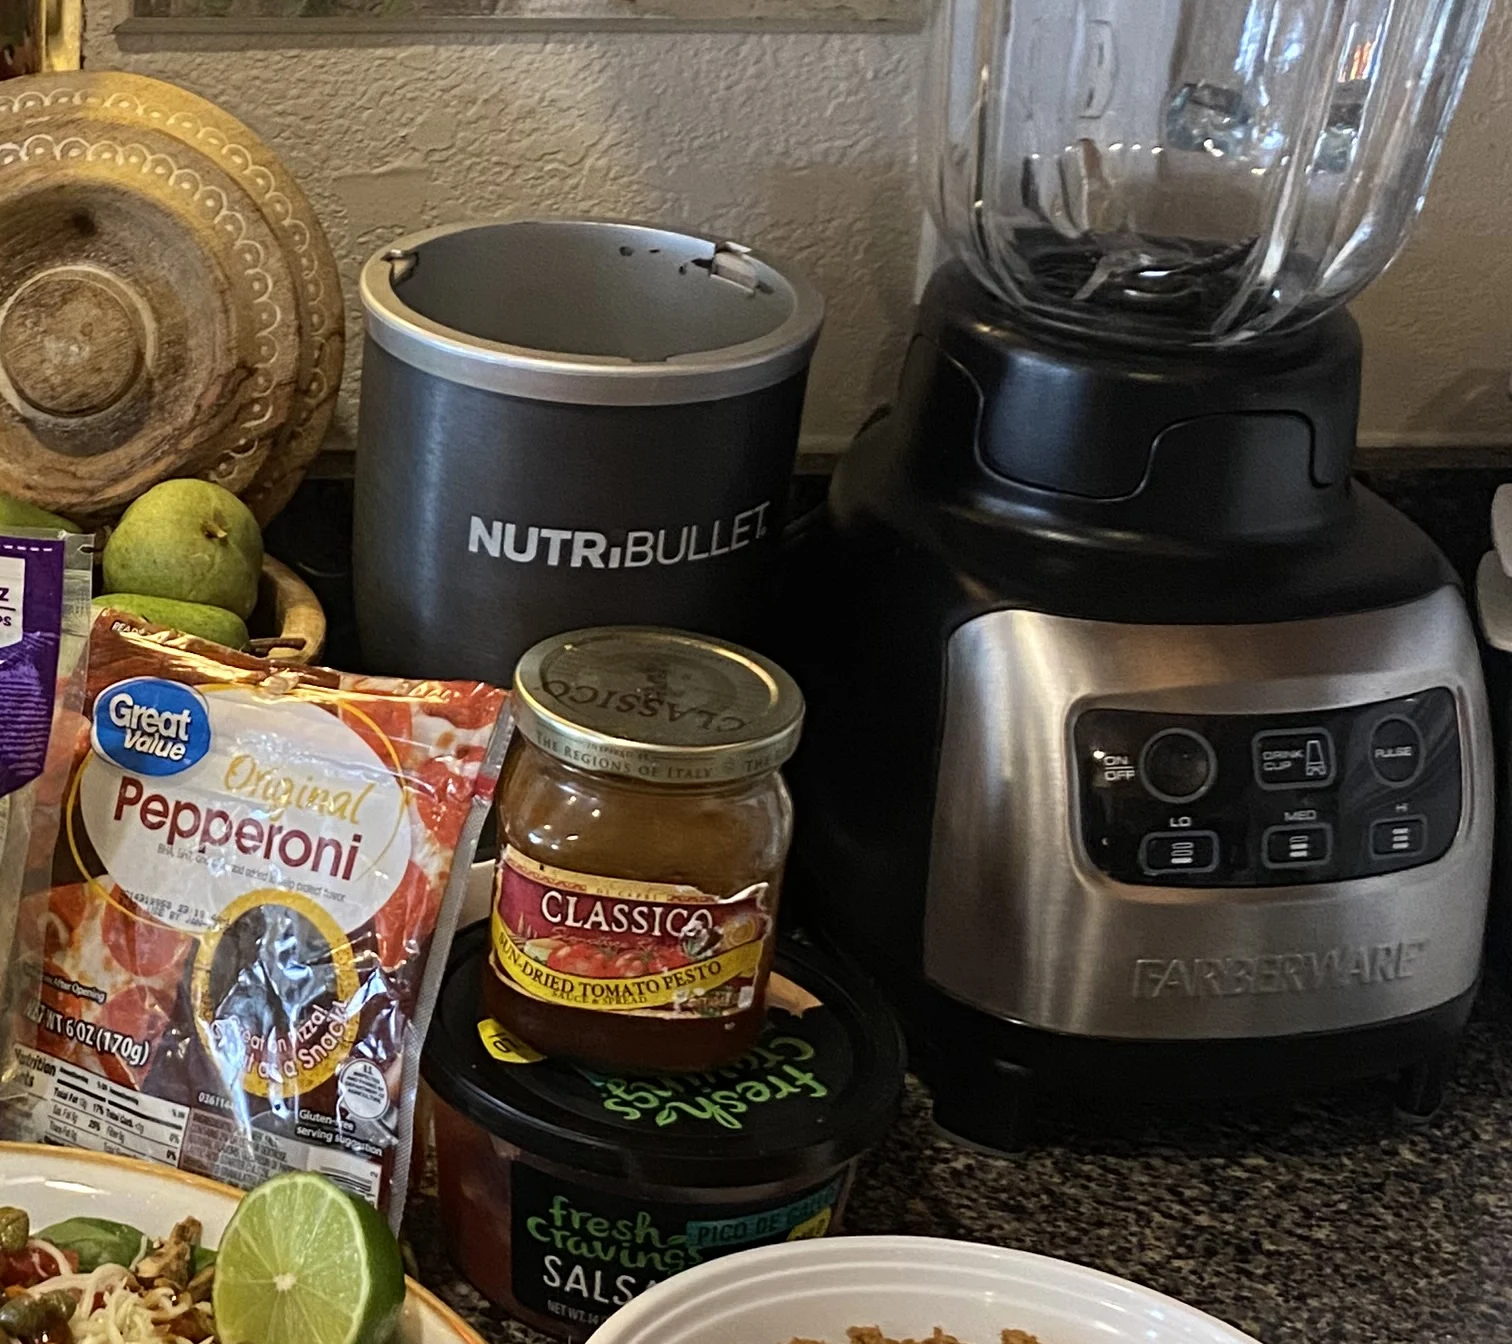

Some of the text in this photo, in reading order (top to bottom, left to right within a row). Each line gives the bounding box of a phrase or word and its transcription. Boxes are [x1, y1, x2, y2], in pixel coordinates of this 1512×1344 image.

[109, 693, 192, 742] Great
[538, 731, 713, 780] THE REGIONS OF ITALY
[1103, 755, 1129, 766] ON
[1261, 749, 1304, 761] DRINK
[1263, 761, 1292, 772] CUP
[1374, 746, 1413, 758] PULSE
[224, 754, 377, 825] Original
[1104, 769, 1136, 782] OFF
[114, 776, 363, 881] Pepperoni
[1169, 816, 1192, 828] LO
[1284, 809, 1317, 821] MED
[541, 890, 714, 938] CLASSICO
[498, 931, 722, 999] SUN-DRIED TOMATO PESTO
[1132, 938, 1428, 998] FARBERWARE
[52, 979, 72, 994] After
[72, 984, 106, 1003] Opening
[551, 990, 589, 1004] SAUCE
[601, 995, 648, 1005] SPREAD
[65, 1020, 75, 1037] 6
[76, 1023, 94, 1045] OZ
[97, 1028, 149, 1065] (170g)
[284, 1061, 298, 1077] a
[298, 1001, 348, 1068] Snack
[288, 1004, 329, 1046] izza!
[15, 1048, 56, 1077] Nutrition
[666, 1064, 829, 1130] fresh
[296, 1126, 334, 1143] serving
[549, 1196, 663, 1248] fresh
[697, 1224, 748, 1244] PICO
[755, 1217, 779, 1237] DE
[543, 1255, 659, 1306] SALS
[547, 1299, 567, 1318] NET
